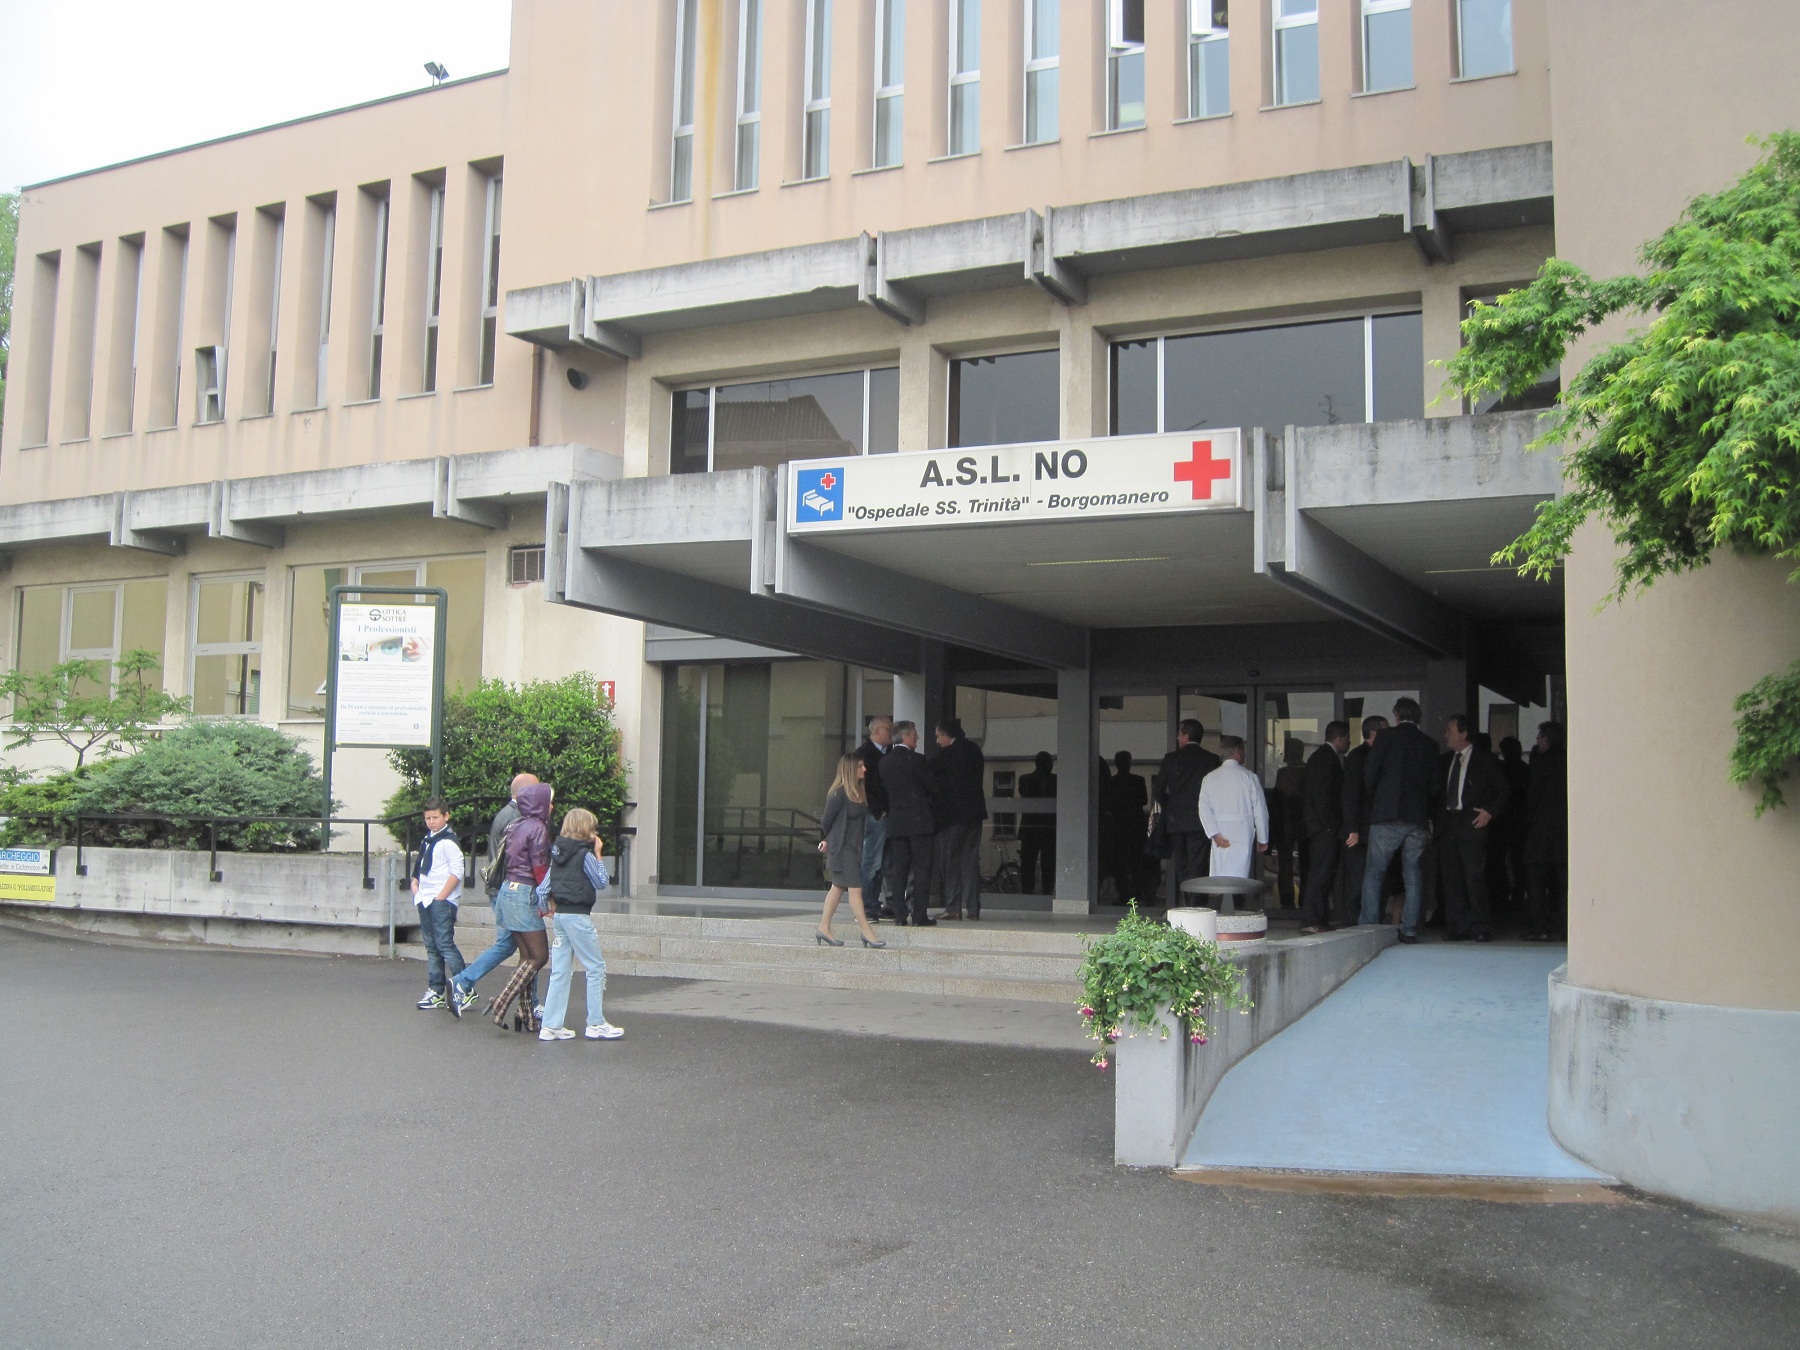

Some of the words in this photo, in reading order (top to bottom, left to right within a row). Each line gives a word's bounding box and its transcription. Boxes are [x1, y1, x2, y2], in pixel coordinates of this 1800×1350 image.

[919, 455, 1020, 488] A.S.L.
[1034, 449, 1088, 481] NO
[848, 502, 929, 521] "Ospedale
[934, 500, 962, 516] SS.
[968, 496, 1030, 513] Trinità"
[1047, 490, 1169, 510] Borgomanero
[364, 625, 417, 633] Professionisti
[0, 851, 39, 861] RCHEGGIO
